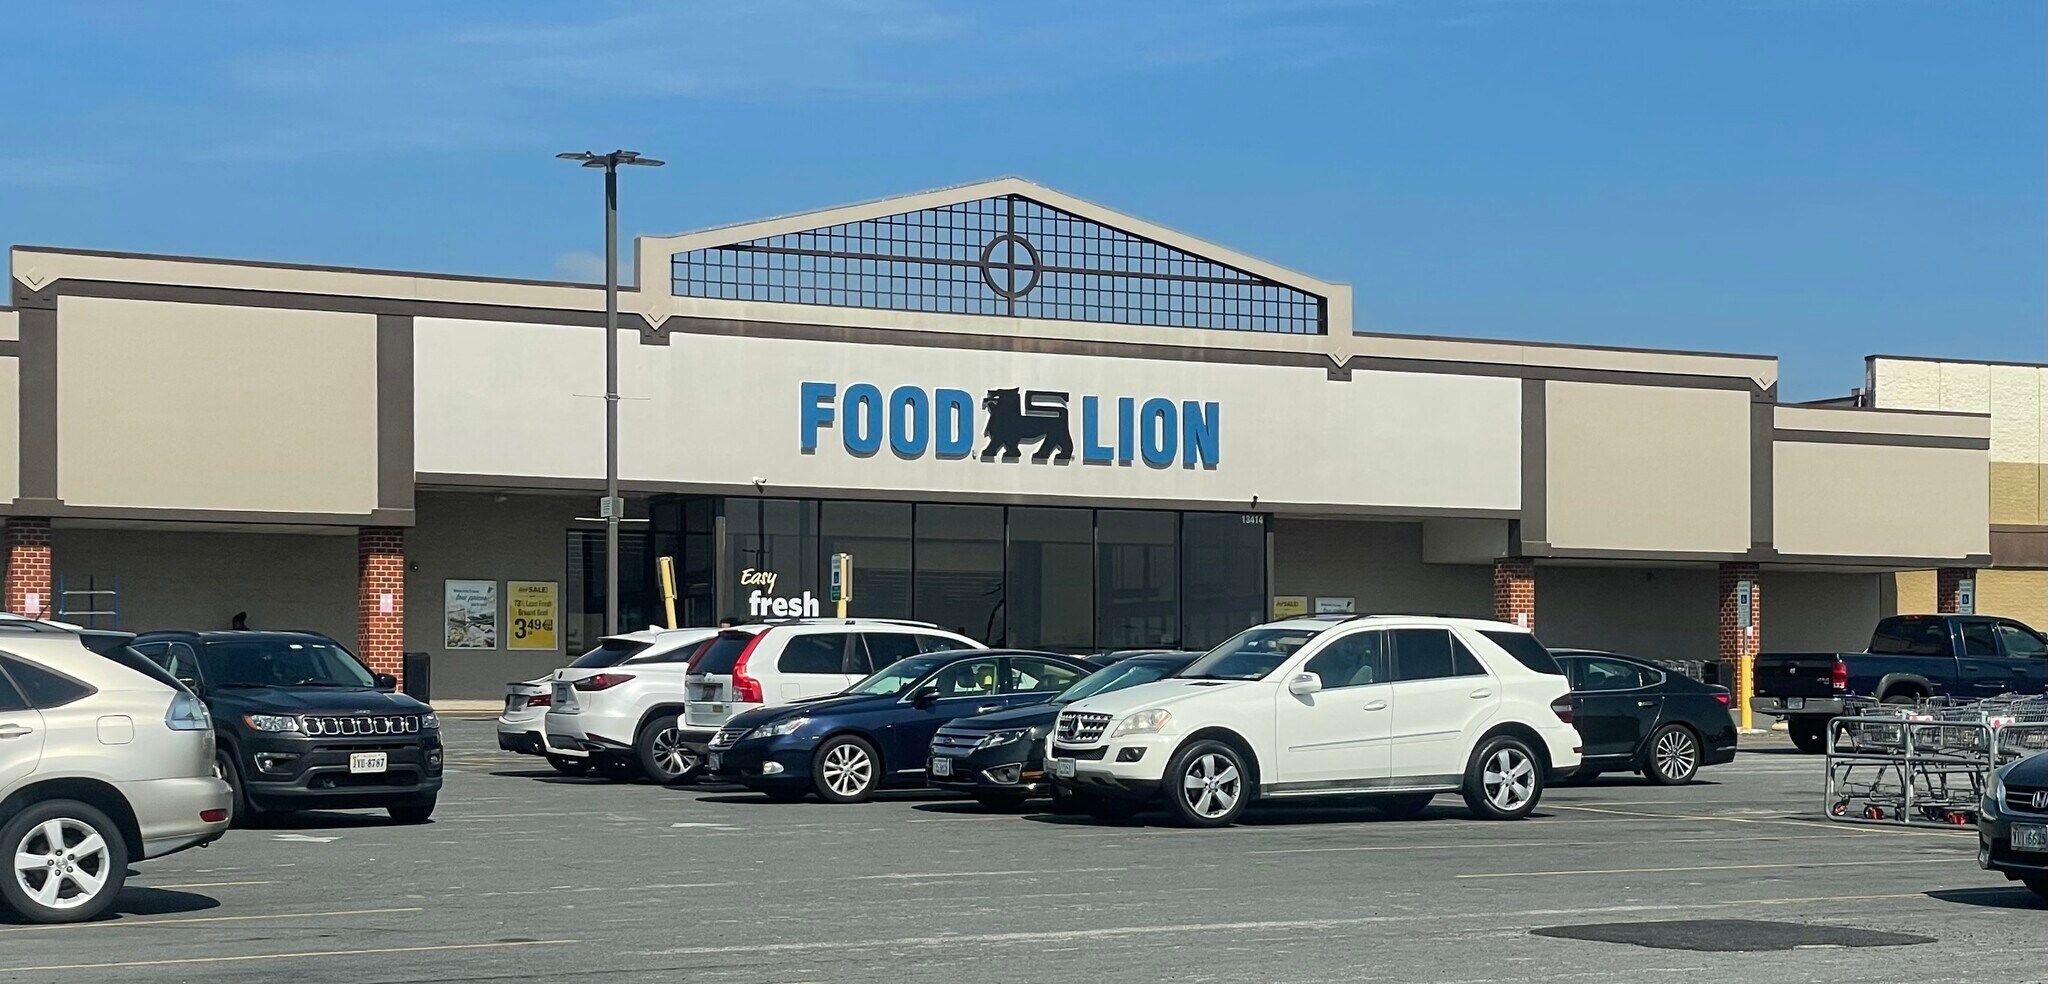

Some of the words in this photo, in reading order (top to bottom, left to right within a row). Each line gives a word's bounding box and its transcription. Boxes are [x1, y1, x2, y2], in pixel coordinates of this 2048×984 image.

[800, 382, 974, 460] FOOD
[1082, 395, 1220, 471] LION
[1241, 515, 1264, 524] 13414
[741, 568, 777, 594] Easy
[749, 590, 819, 617] fresh
[514, 618, 527, 639] 3
[527, 619, 542, 630] 49
